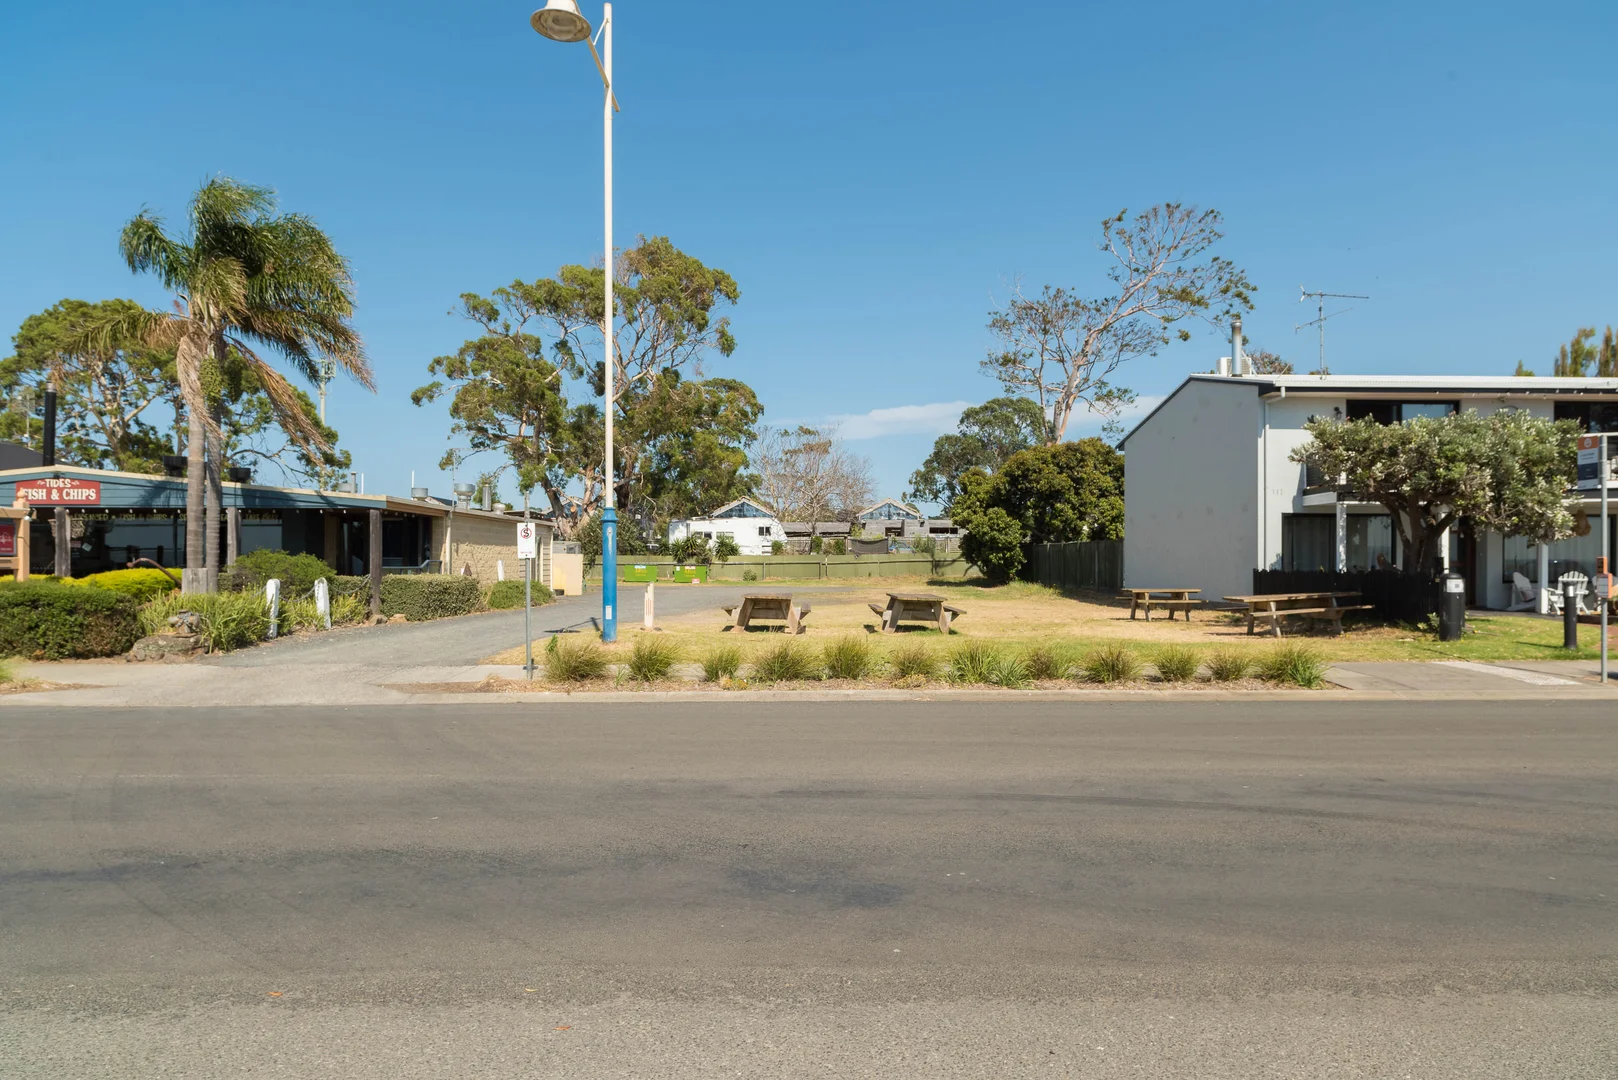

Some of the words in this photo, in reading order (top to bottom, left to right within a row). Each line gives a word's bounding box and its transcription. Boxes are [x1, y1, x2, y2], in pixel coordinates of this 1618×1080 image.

[45, 479, 71, 488] TIDES
[23, 488, 47, 500] FISH
[50, 489, 60, 500] &
[62, 488, 97, 500] CHIPS
